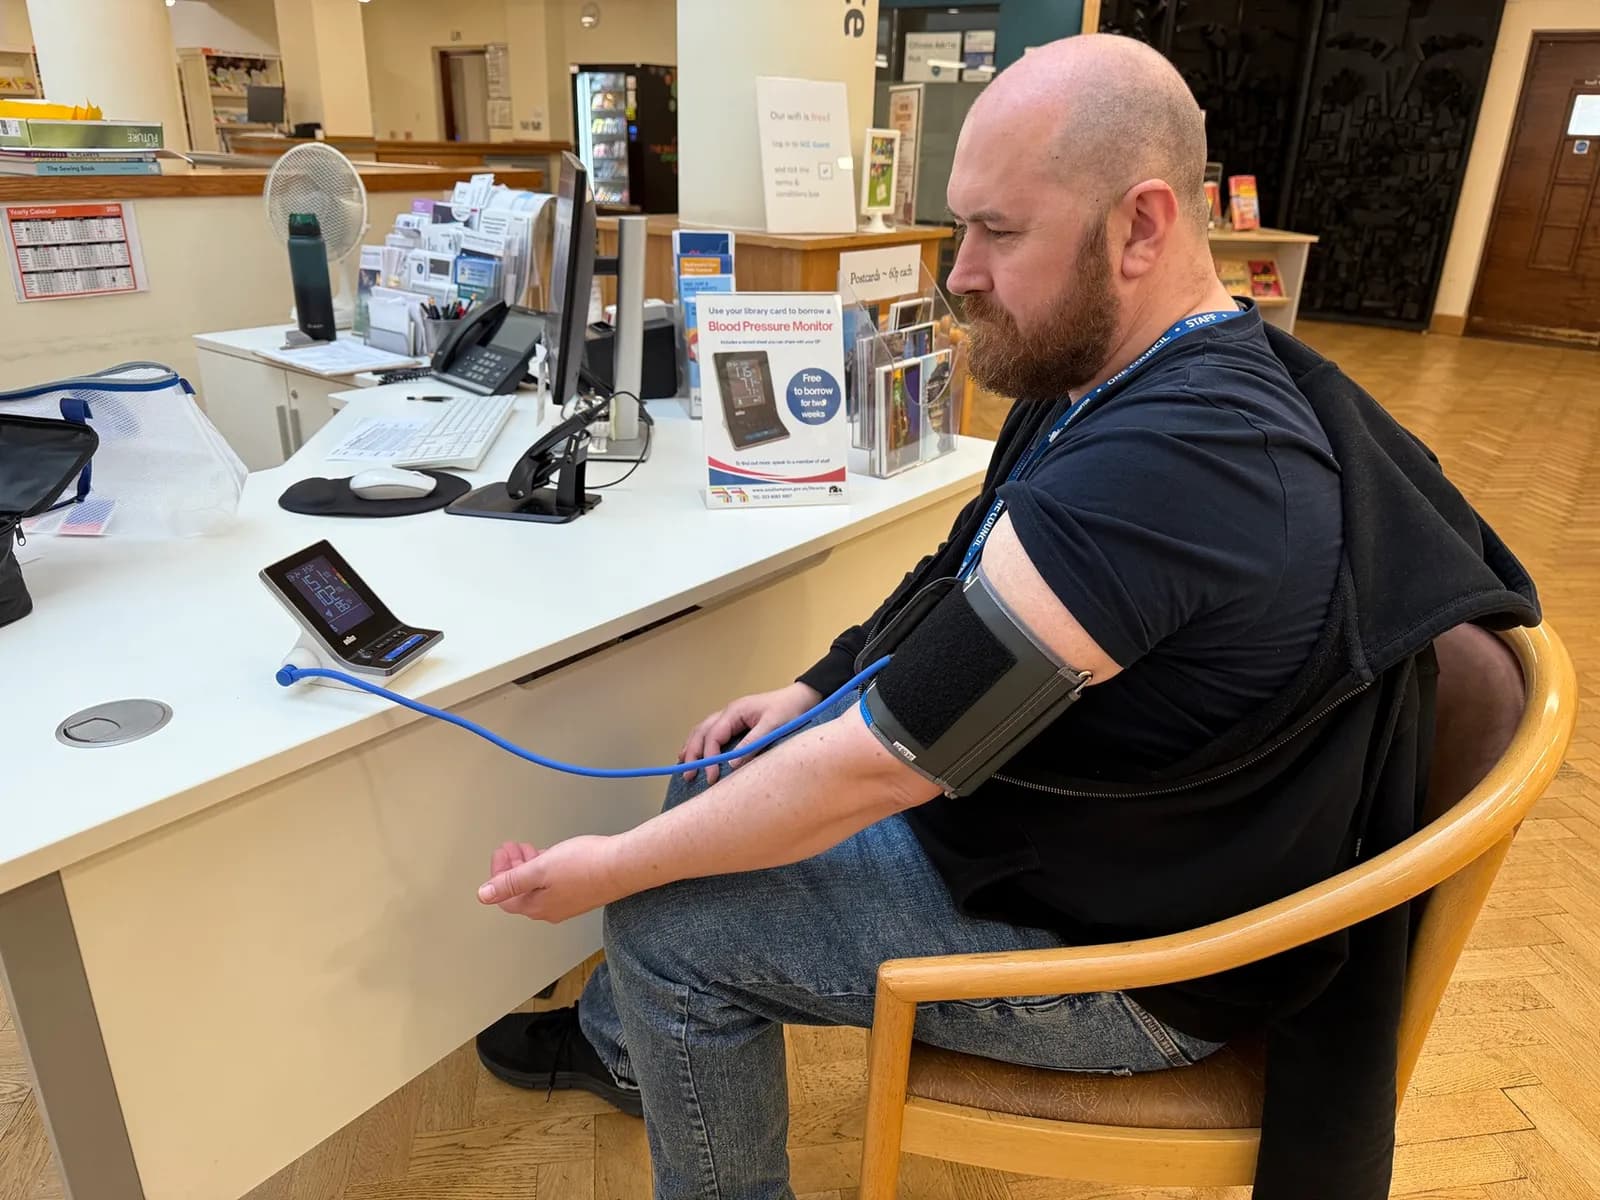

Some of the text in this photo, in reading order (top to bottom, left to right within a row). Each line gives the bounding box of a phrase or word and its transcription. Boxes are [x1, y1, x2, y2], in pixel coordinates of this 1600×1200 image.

[770, 111, 785, 121] Our
[787, 112, 801, 121] wifi
[127, 133, 159, 143] FUTURE
[850, 268, 880, 285] Postcards
[899, 264, 913, 277] each
[708, 307, 723, 315] Use
[725, 308, 743, 316] your
[744, 307, 768, 316] library
[769, 307, 787, 315] card
[798, 307, 824, 315] borrow
[1185, 313, 1217, 328] STAFF
[708, 320, 833, 332] Blood Pressure Monitor
[1107, 335, 1171, 385] ONE COUNCIL
[802, 373, 822, 383] Free
[793, 386, 834, 396] to borrow
[801, 398, 811, 407] for
[801, 410, 826, 418] weeks
[973, 513, 997, 547] COUNCIL
